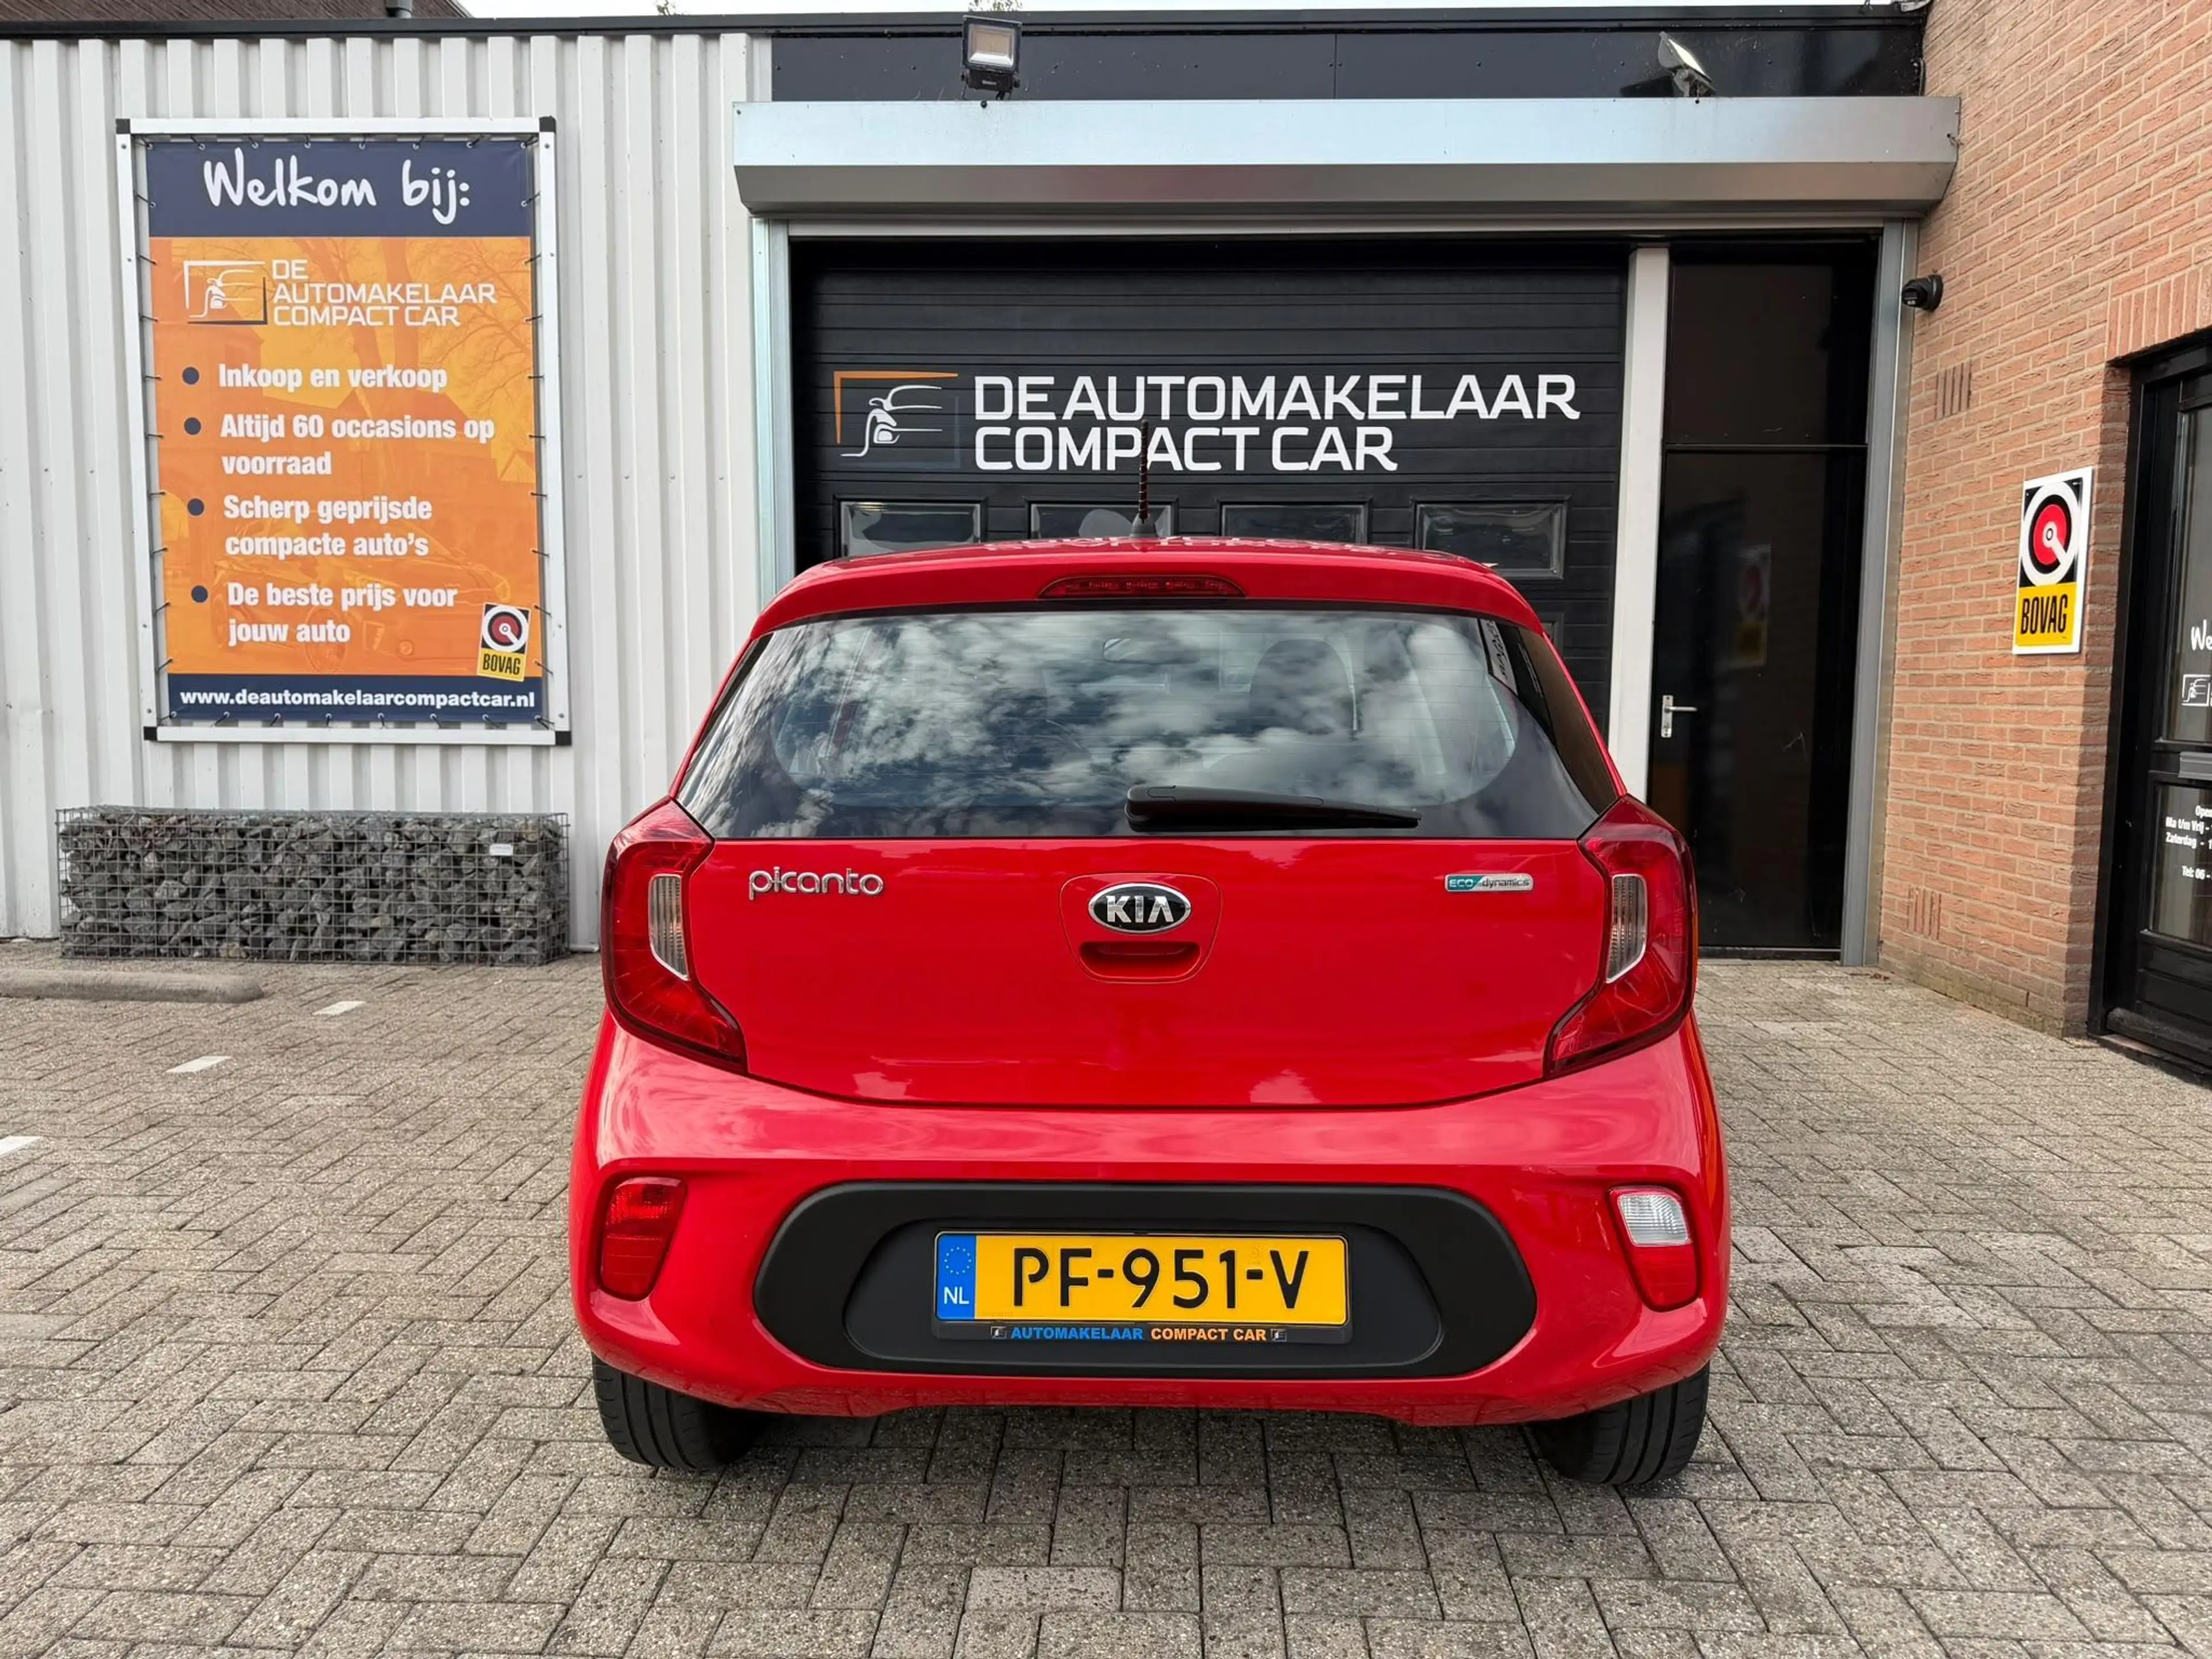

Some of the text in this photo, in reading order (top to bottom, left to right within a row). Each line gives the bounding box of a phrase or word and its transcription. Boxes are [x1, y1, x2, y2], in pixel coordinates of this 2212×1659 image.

[203, 147, 471, 225] Welkom bij:
[271, 259, 309, 280] DE
[272, 282, 498, 304] AUTOMAKELAAR
[273, 305, 461, 326] COMPACT CAR
[219, 364, 447, 392] Inkoop en verkoop
[975, 374, 1581, 421] DE AUTOMAKELAAR
[220, 414, 495, 444] Altijd 60 occasions op
[975, 426, 1398, 471] COMPACT CAR
[222, 452, 332, 475] voorraad
[224, 495, 432, 524] Scherp geprijsde
[225, 533, 429, 559] compacte auto's
[228, 582, 458, 610] De beste prijs voor
[2020, 593, 2069, 634] BOVAG
[228, 620, 351, 647] jouw auto
[483, 653, 522, 675] BOVAG
[180, 688, 535, 709] www.deautomakelaarcompactcar.nl
[2165, 831, 2196, 849] Zaterdag
[748, 866, 884, 900] picanto
[1449, 878, 1530, 889] ECO dynamics
[1105, 895, 1175, 923] KIA
[1013, 1247, 1309, 1309] PF-951-V
[944, 1286, 969, 1305] NL
[1011, 1327, 1267, 1342] AUTOMAKELAAR COMPACT CAR
